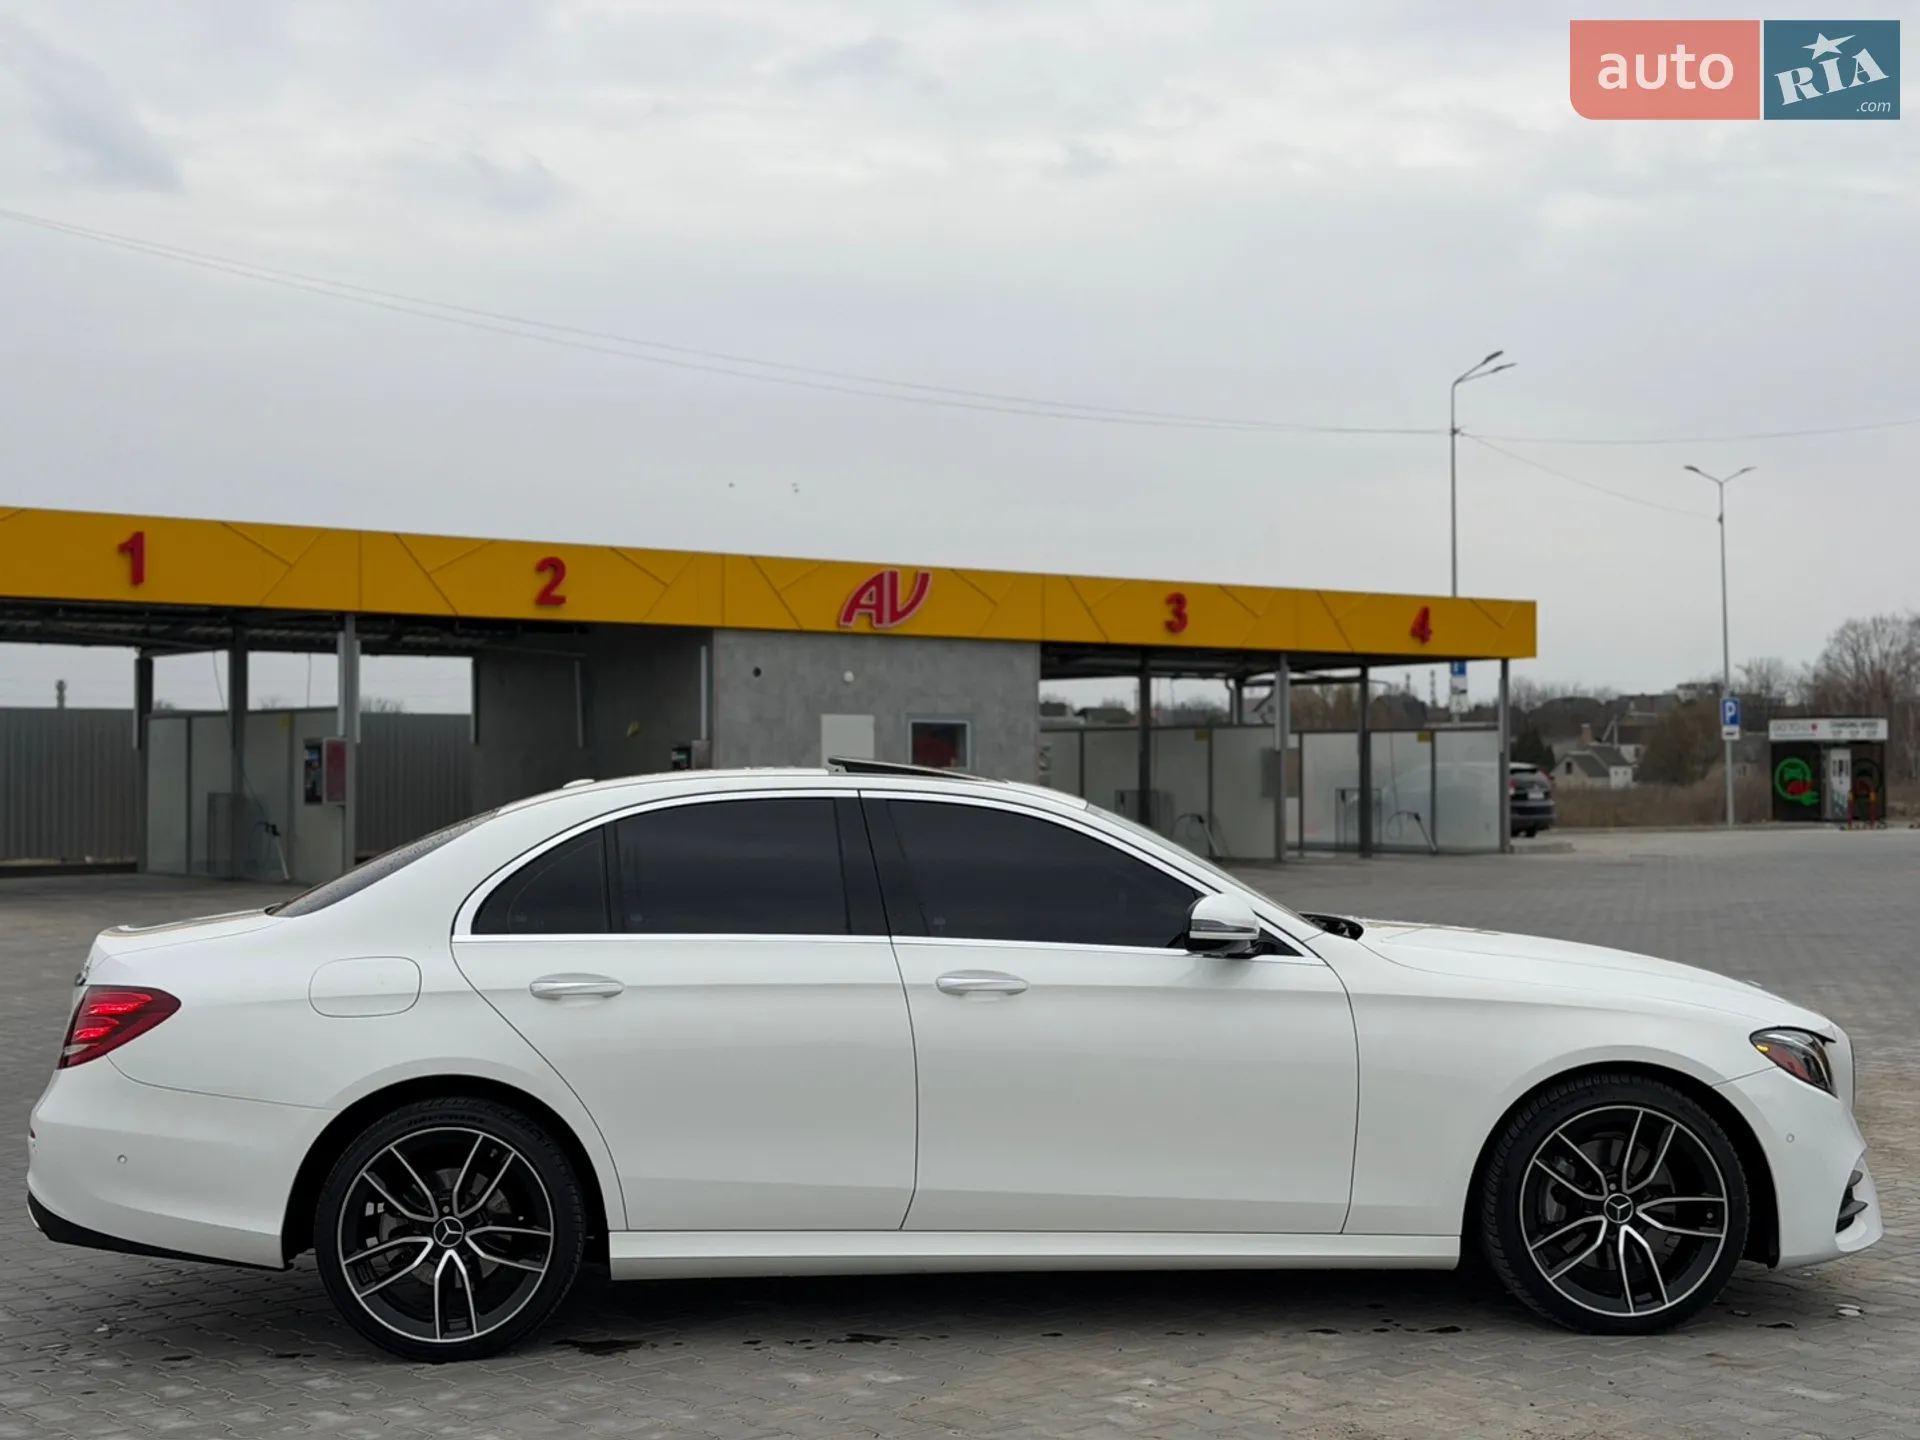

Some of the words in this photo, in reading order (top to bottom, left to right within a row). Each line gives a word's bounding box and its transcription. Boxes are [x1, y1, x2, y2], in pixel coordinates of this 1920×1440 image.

[117, 531, 146, 587] 1
[535, 556, 567, 606] 2
[839, 569, 932, 628] AV
[1164, 592, 1188, 634] 3
[1409, 606, 1433, 645] 4
[1724, 701, 1737, 725] P
